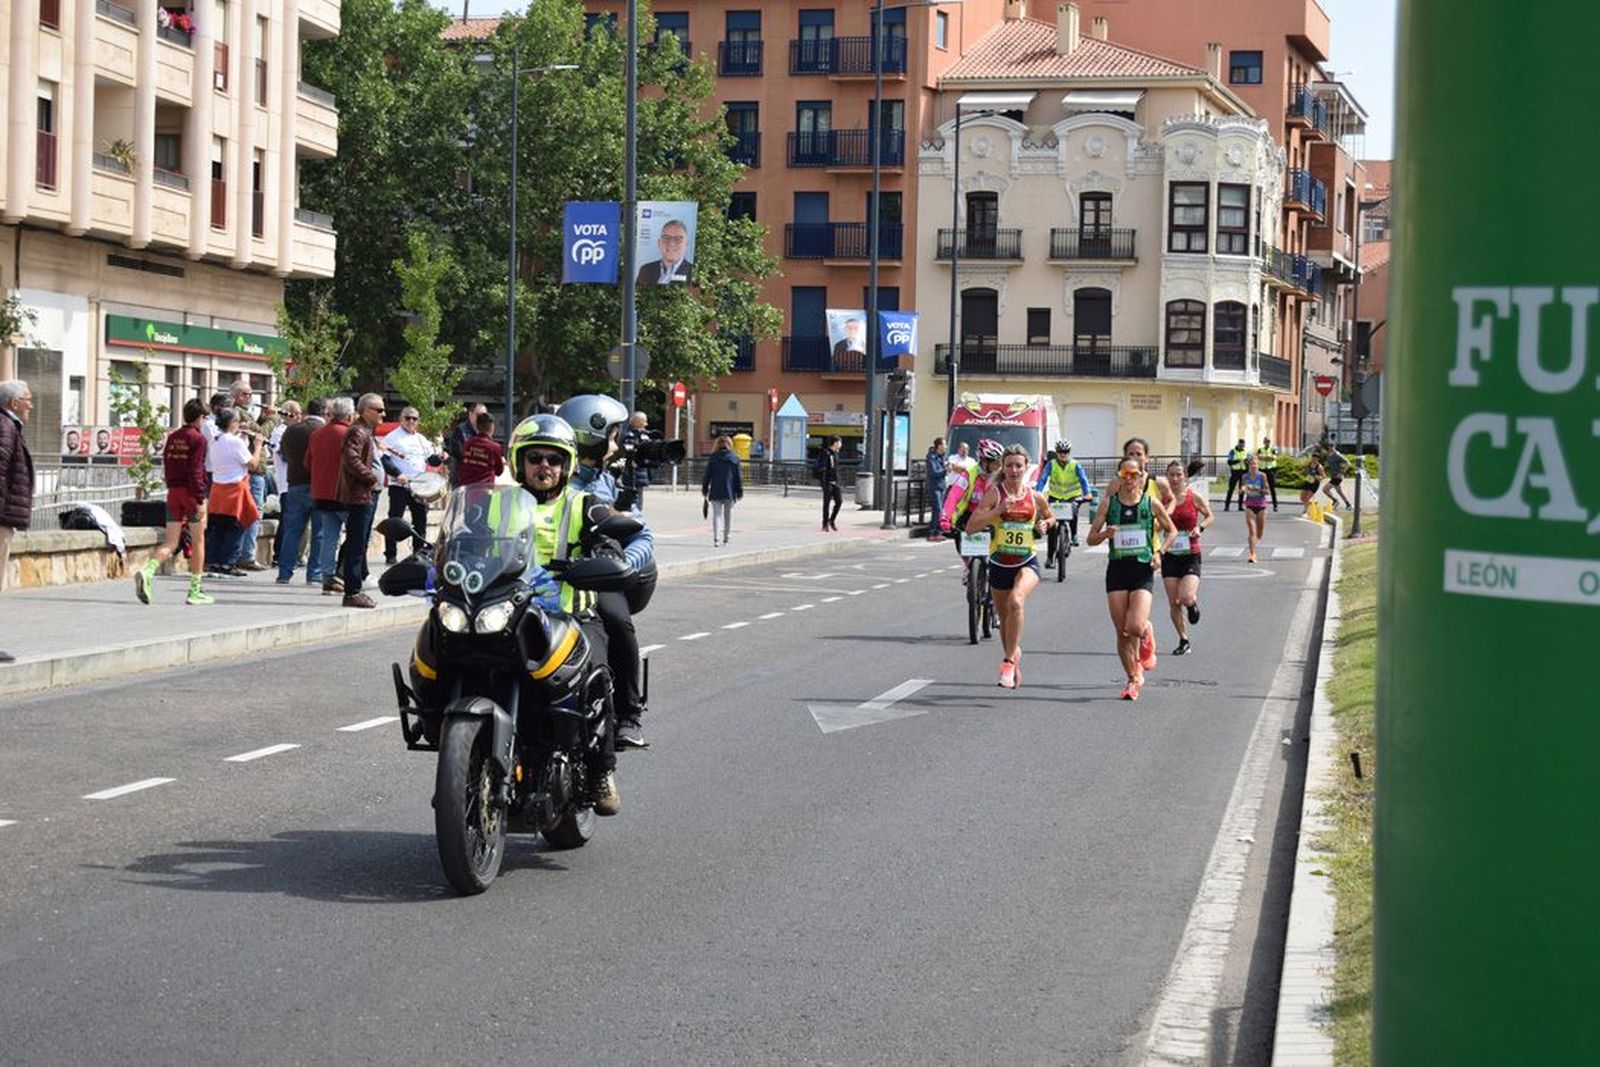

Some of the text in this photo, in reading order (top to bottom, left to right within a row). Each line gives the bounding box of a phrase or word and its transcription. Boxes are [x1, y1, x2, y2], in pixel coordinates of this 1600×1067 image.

[573, 224, 607, 236] VOTA
[886, 321, 911, 330] VOTA
[1448, 286, 1600, 394] FU
[1447, 411, 1600, 535] CA
[1005, 531, 1024, 546] 36
[1456, 558, 1517, 590] LEÓN
